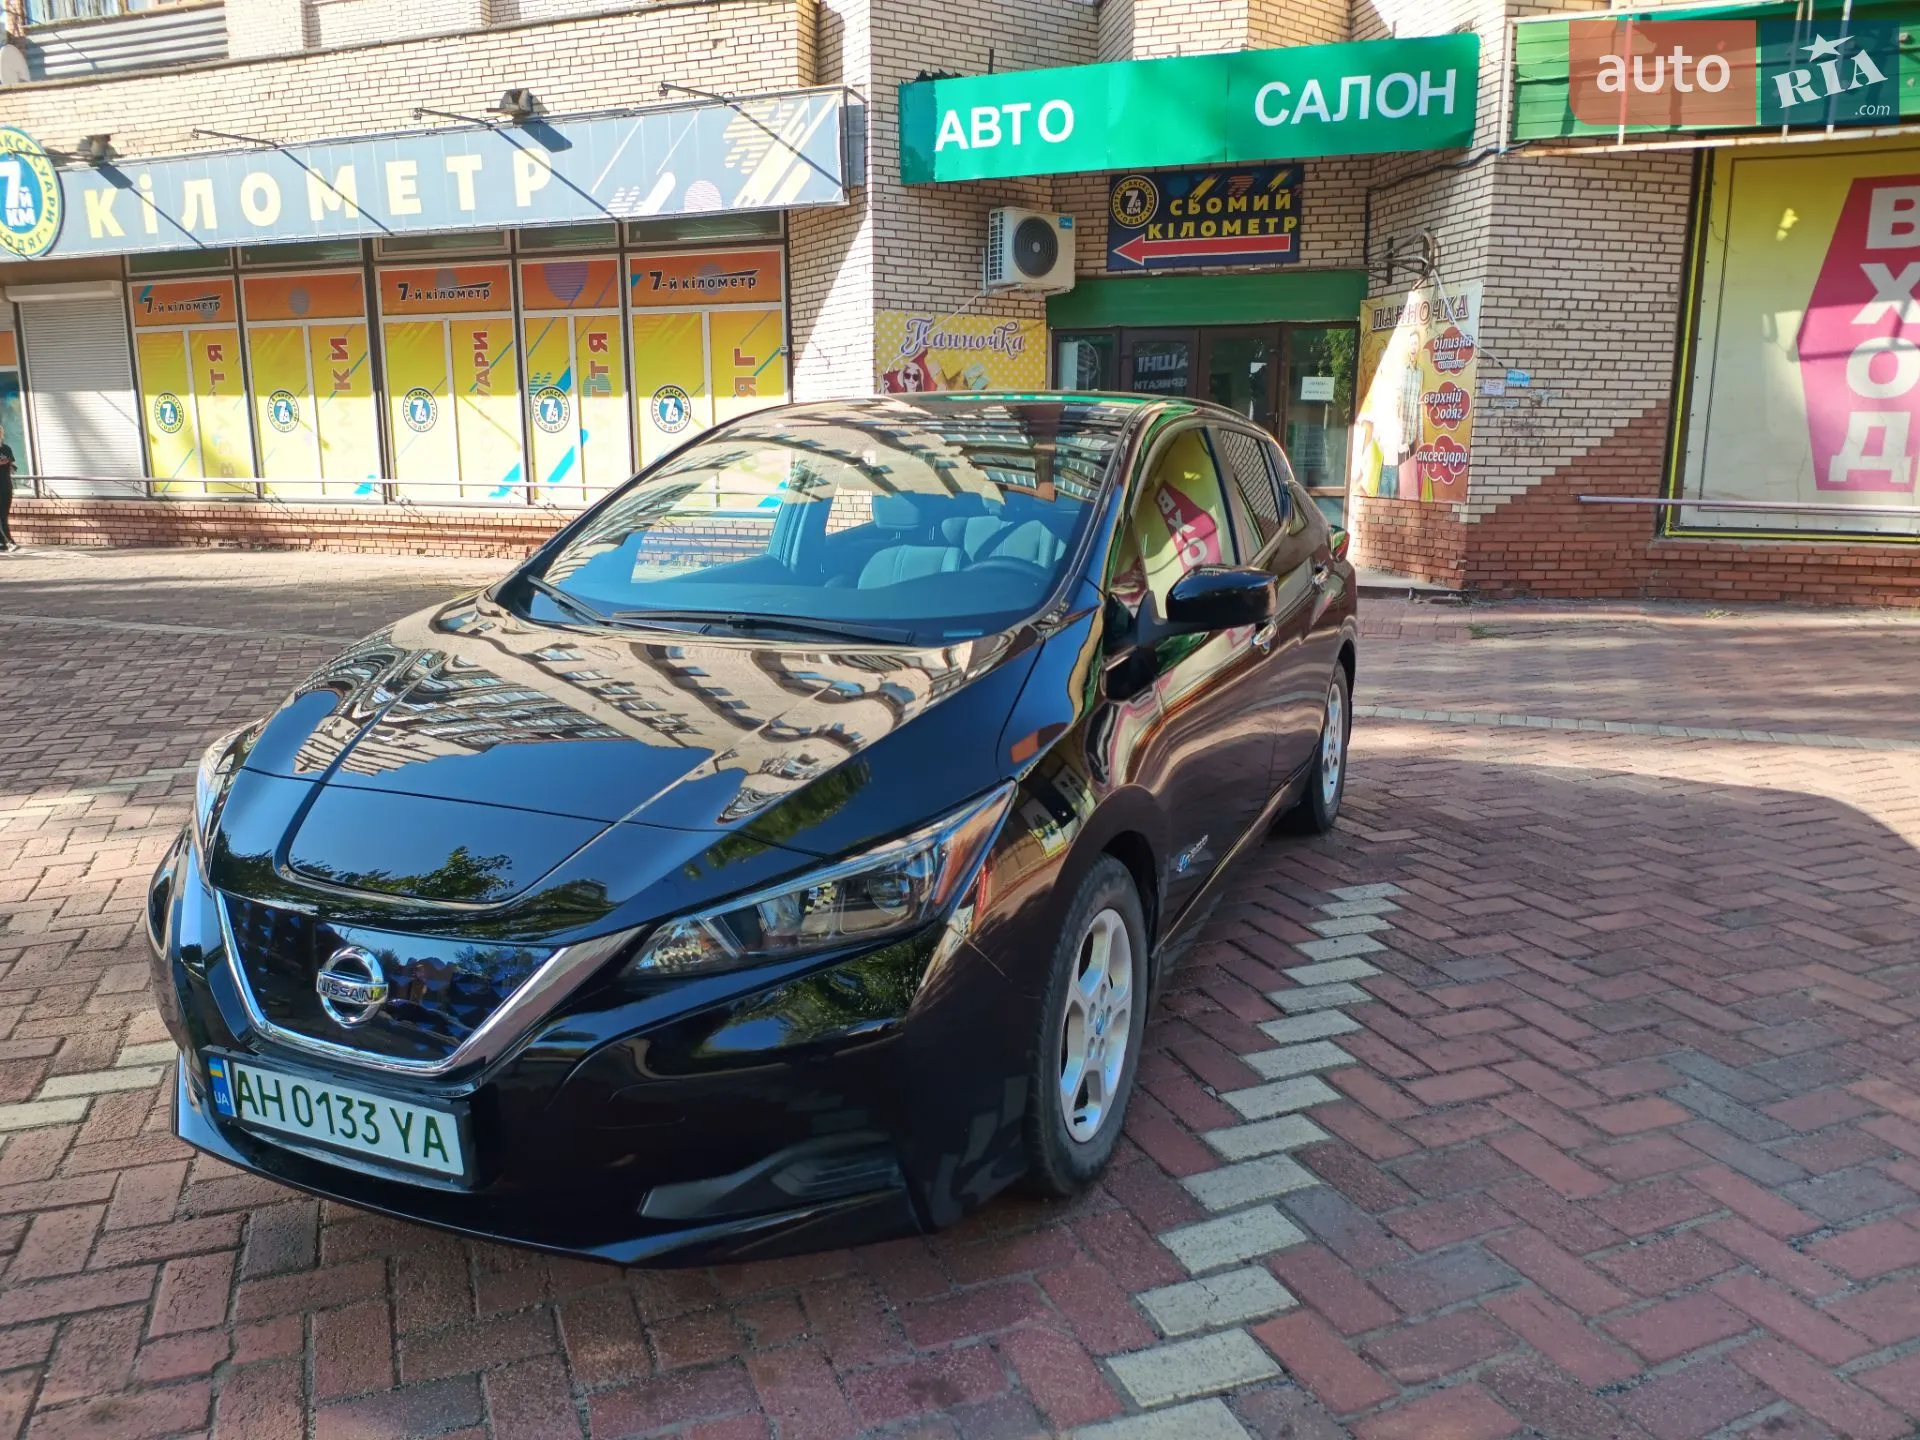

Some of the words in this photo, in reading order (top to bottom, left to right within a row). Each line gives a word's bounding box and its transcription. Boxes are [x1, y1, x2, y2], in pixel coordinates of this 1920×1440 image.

[935, 100, 1075, 152] АВТО
[1255, 69, 1457, 126] САЛОН
[1169, 189, 1291, 217] СЬОМИЙ
[1148, 216, 1298, 240] КІЛОМЕТР
[426, 287, 491, 300] кілометр
[682, 275, 757, 290] кілометр
[167, 301, 222, 313] кілометр
[1371, 294, 1469, 331] ПАННОЧКА
[901, 318, 1025, 359] Панночка
[1828, 185, 1920, 484] ВХОД
[1424, 390, 1462, 407] верхній
[1440, 404, 1463, 420] одяг
[1417, 446, 1468, 468] аксесуари
[319, 980, 374, 1001] NISSAN
[214, 1089, 231, 1106] UA
[237, 1069, 287, 1123] AH
[291, 1084, 381, 1145] 0133
[390, 1106, 449, 1163] YA
